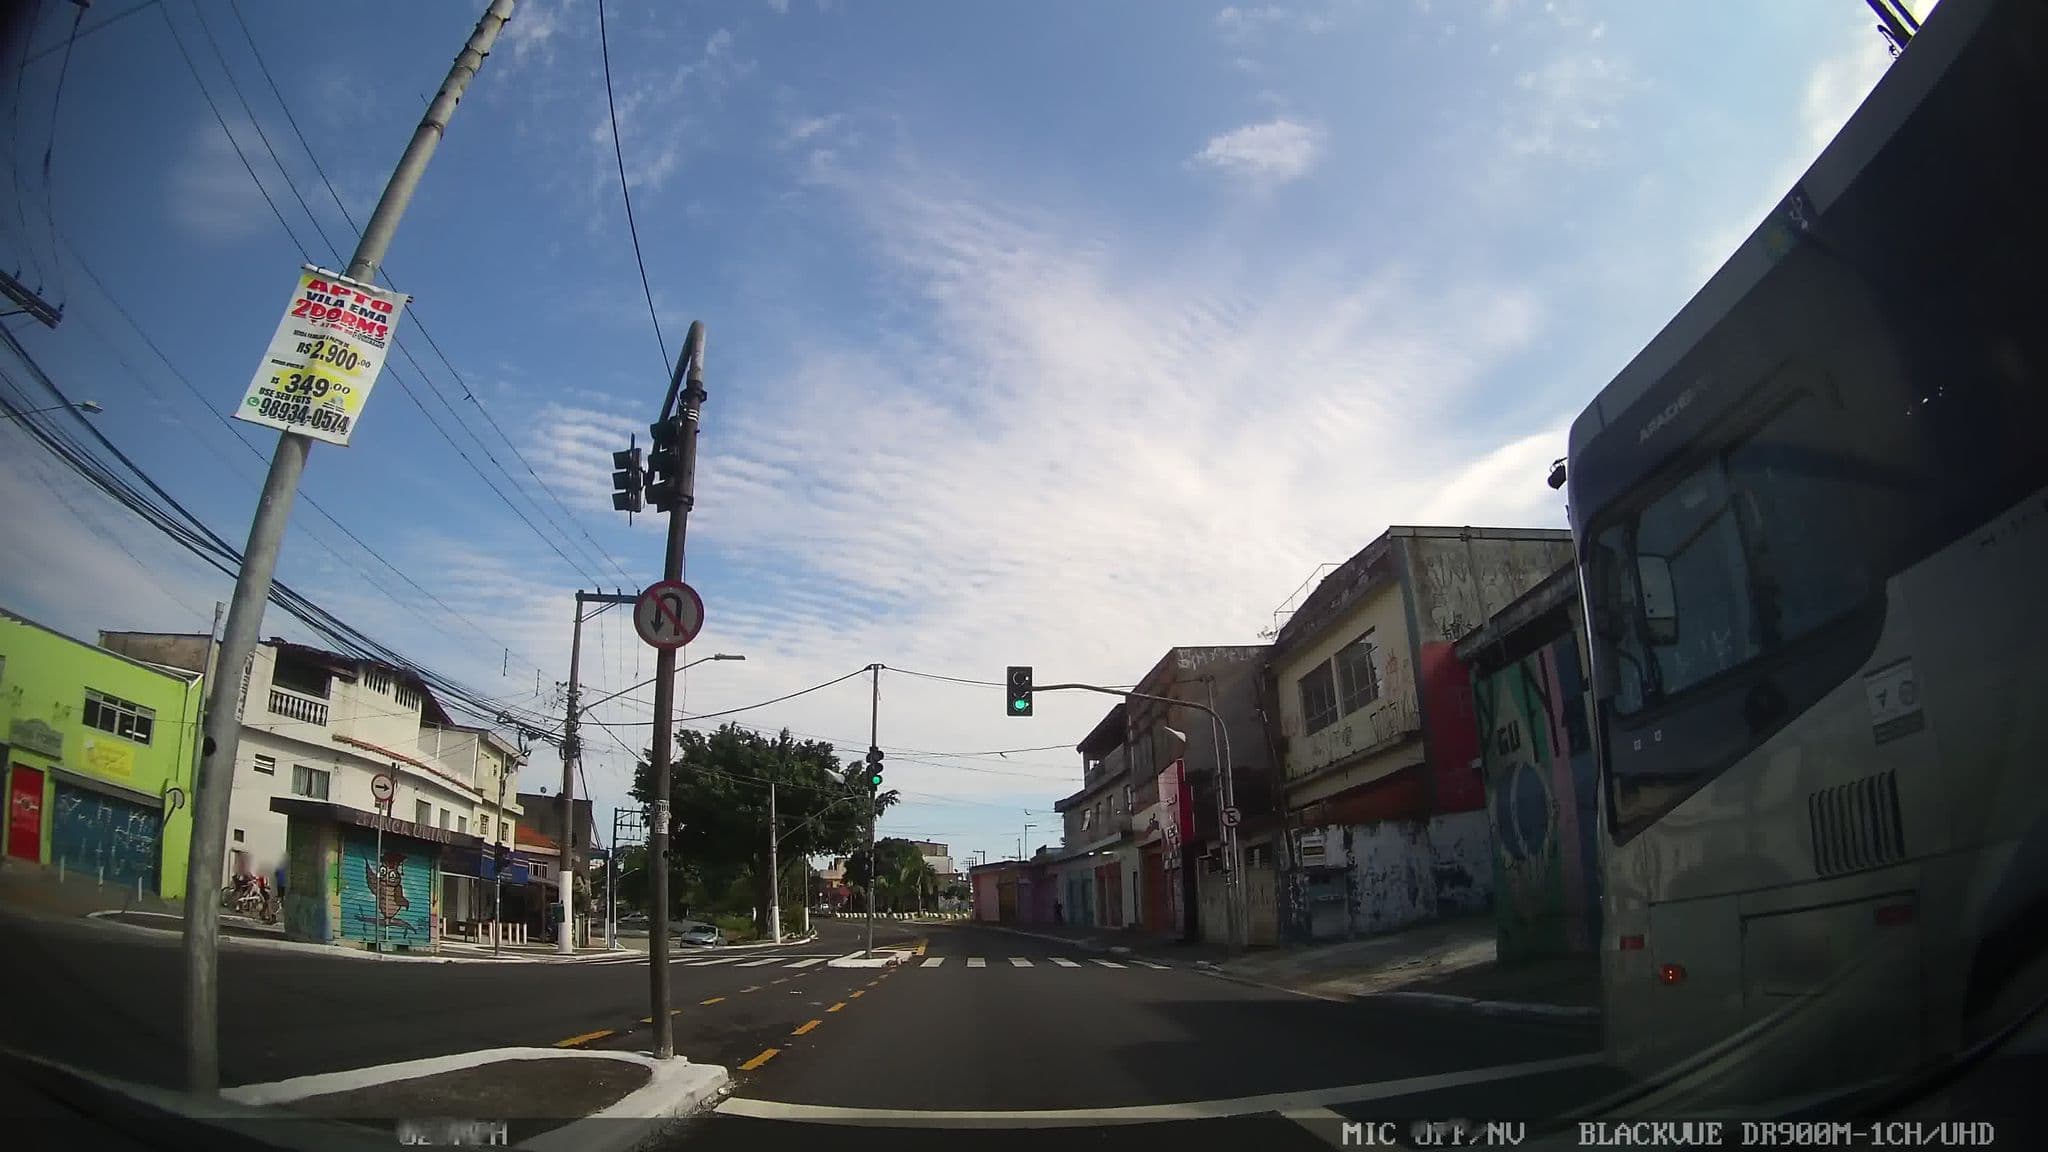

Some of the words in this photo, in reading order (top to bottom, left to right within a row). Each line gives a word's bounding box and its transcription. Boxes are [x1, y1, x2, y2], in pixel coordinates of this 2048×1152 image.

[306, 279, 393, 314] APTO
[306, 291, 345, 308] VILA
[351, 304, 387, 324] EMA
[259, 387, 275, 398] USE
[291, 394, 313, 405] FGTS
[258, 397, 350, 434] 98934-0574
